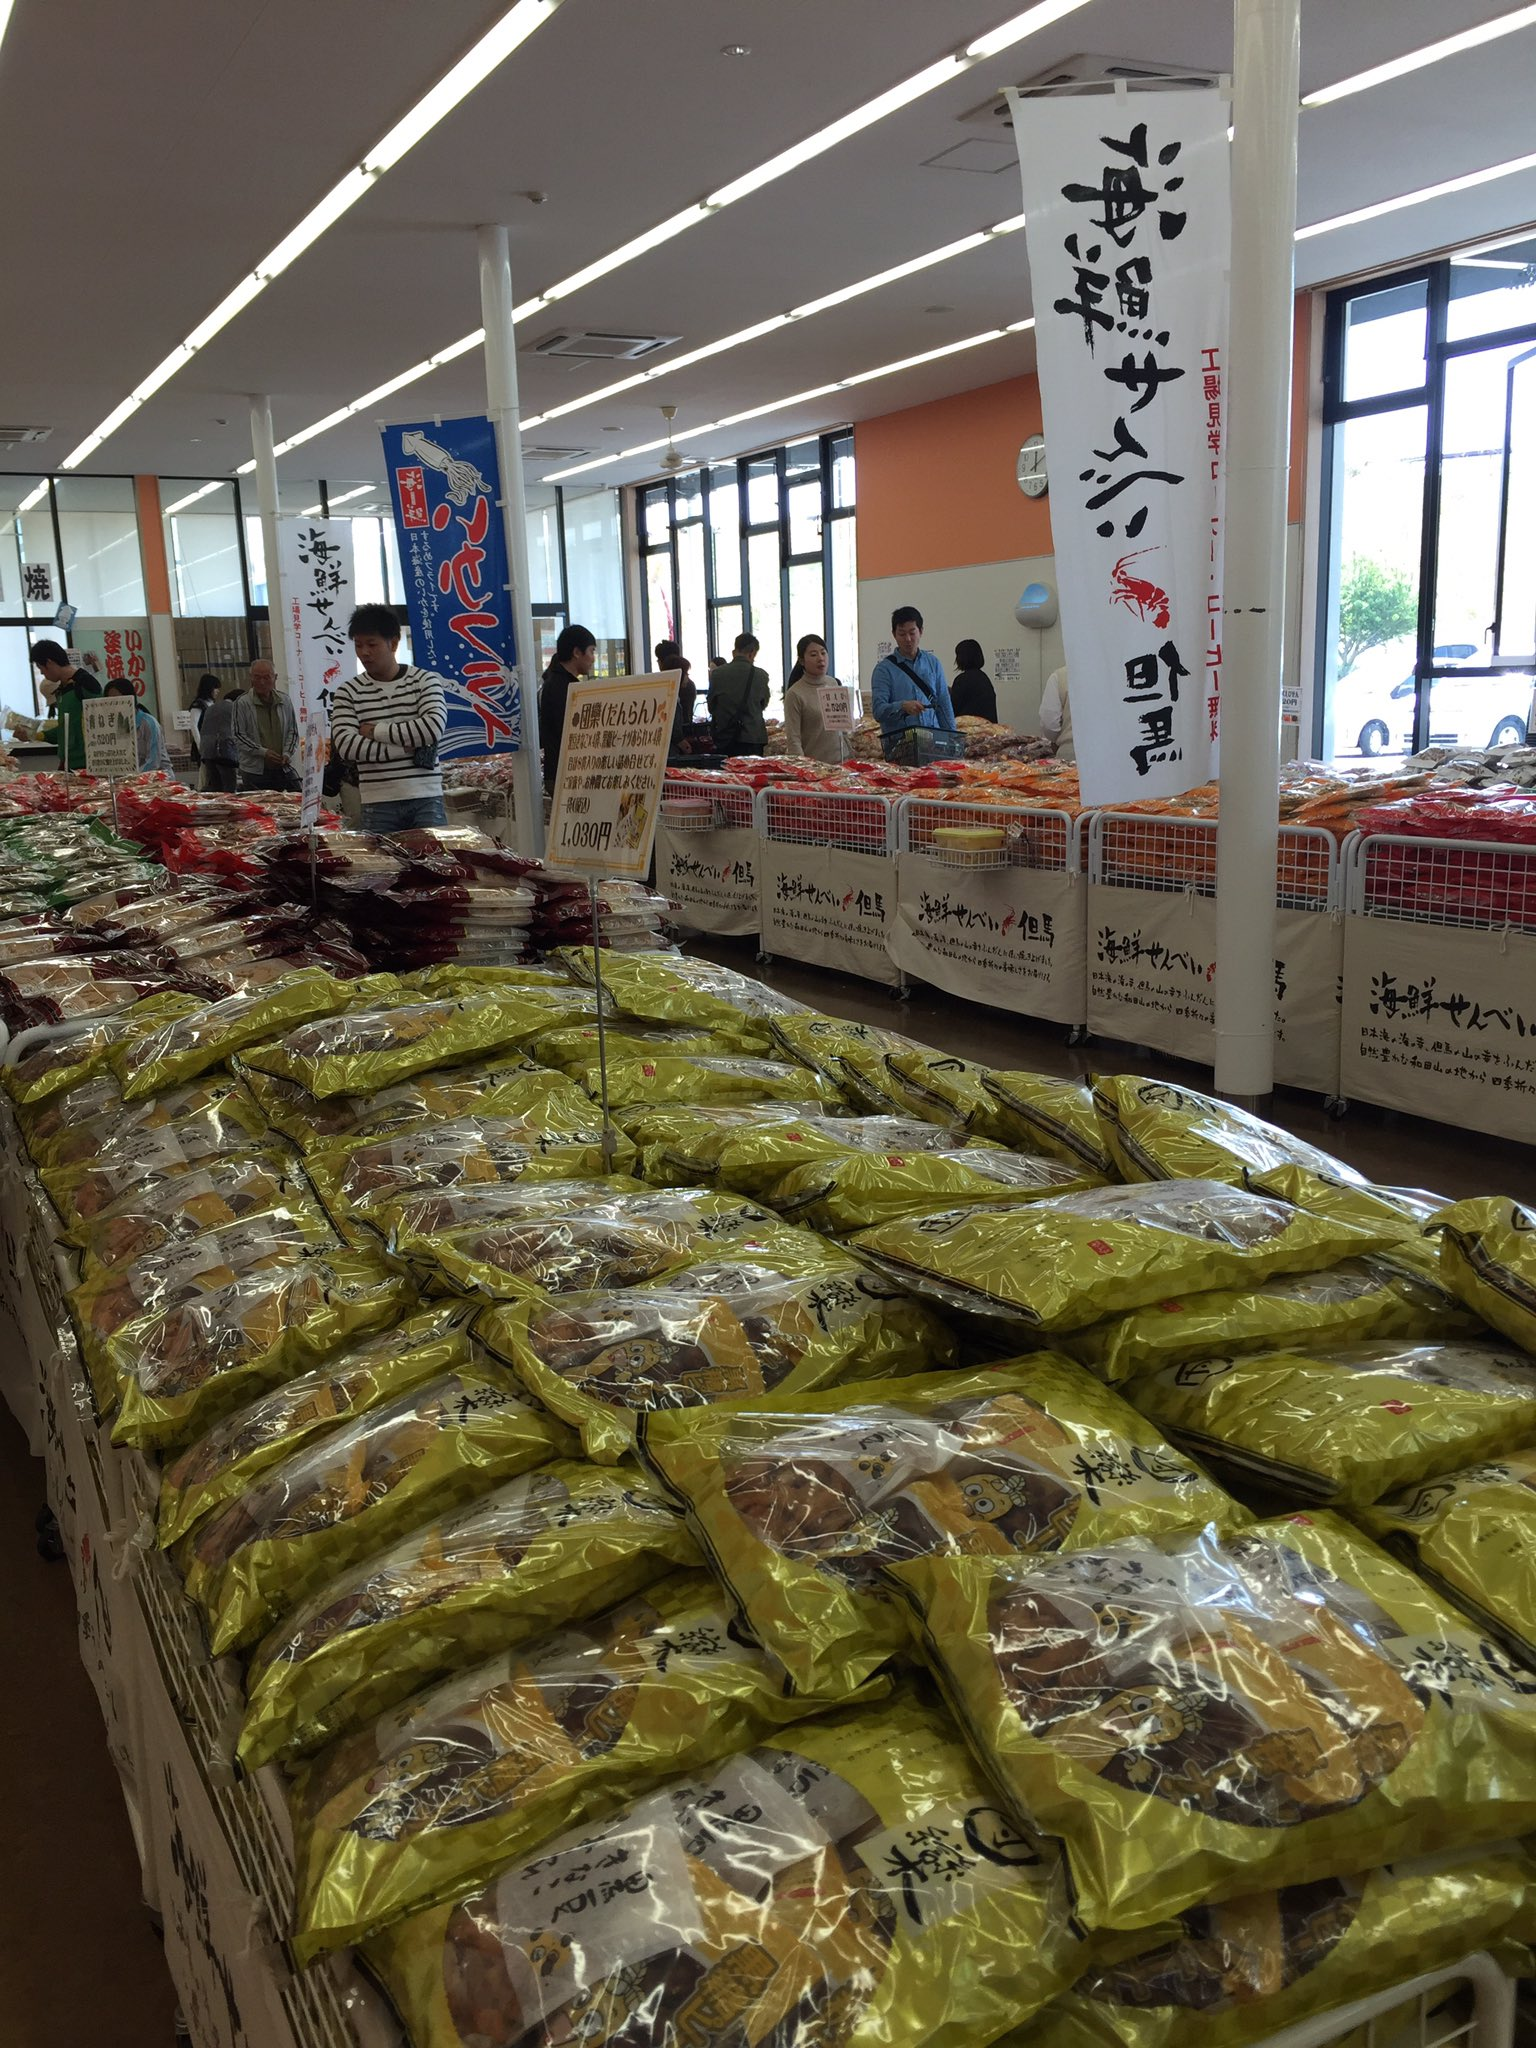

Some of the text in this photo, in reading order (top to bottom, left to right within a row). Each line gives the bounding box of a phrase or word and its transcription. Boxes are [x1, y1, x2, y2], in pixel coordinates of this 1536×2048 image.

[24, 564, 50, 601] 焼
[297, 527, 348, 656] 海鮮せんべい
[124, 629, 146, 697] いかの
[855, 889, 886, 923] 但馬
[918, 891, 1055, 948] 海鮮せんべい 但馬
[1097, 926, 1203, 975] 海鮮せんべい
[1369, 971, 1536, 1038] 海鮮せんべい
